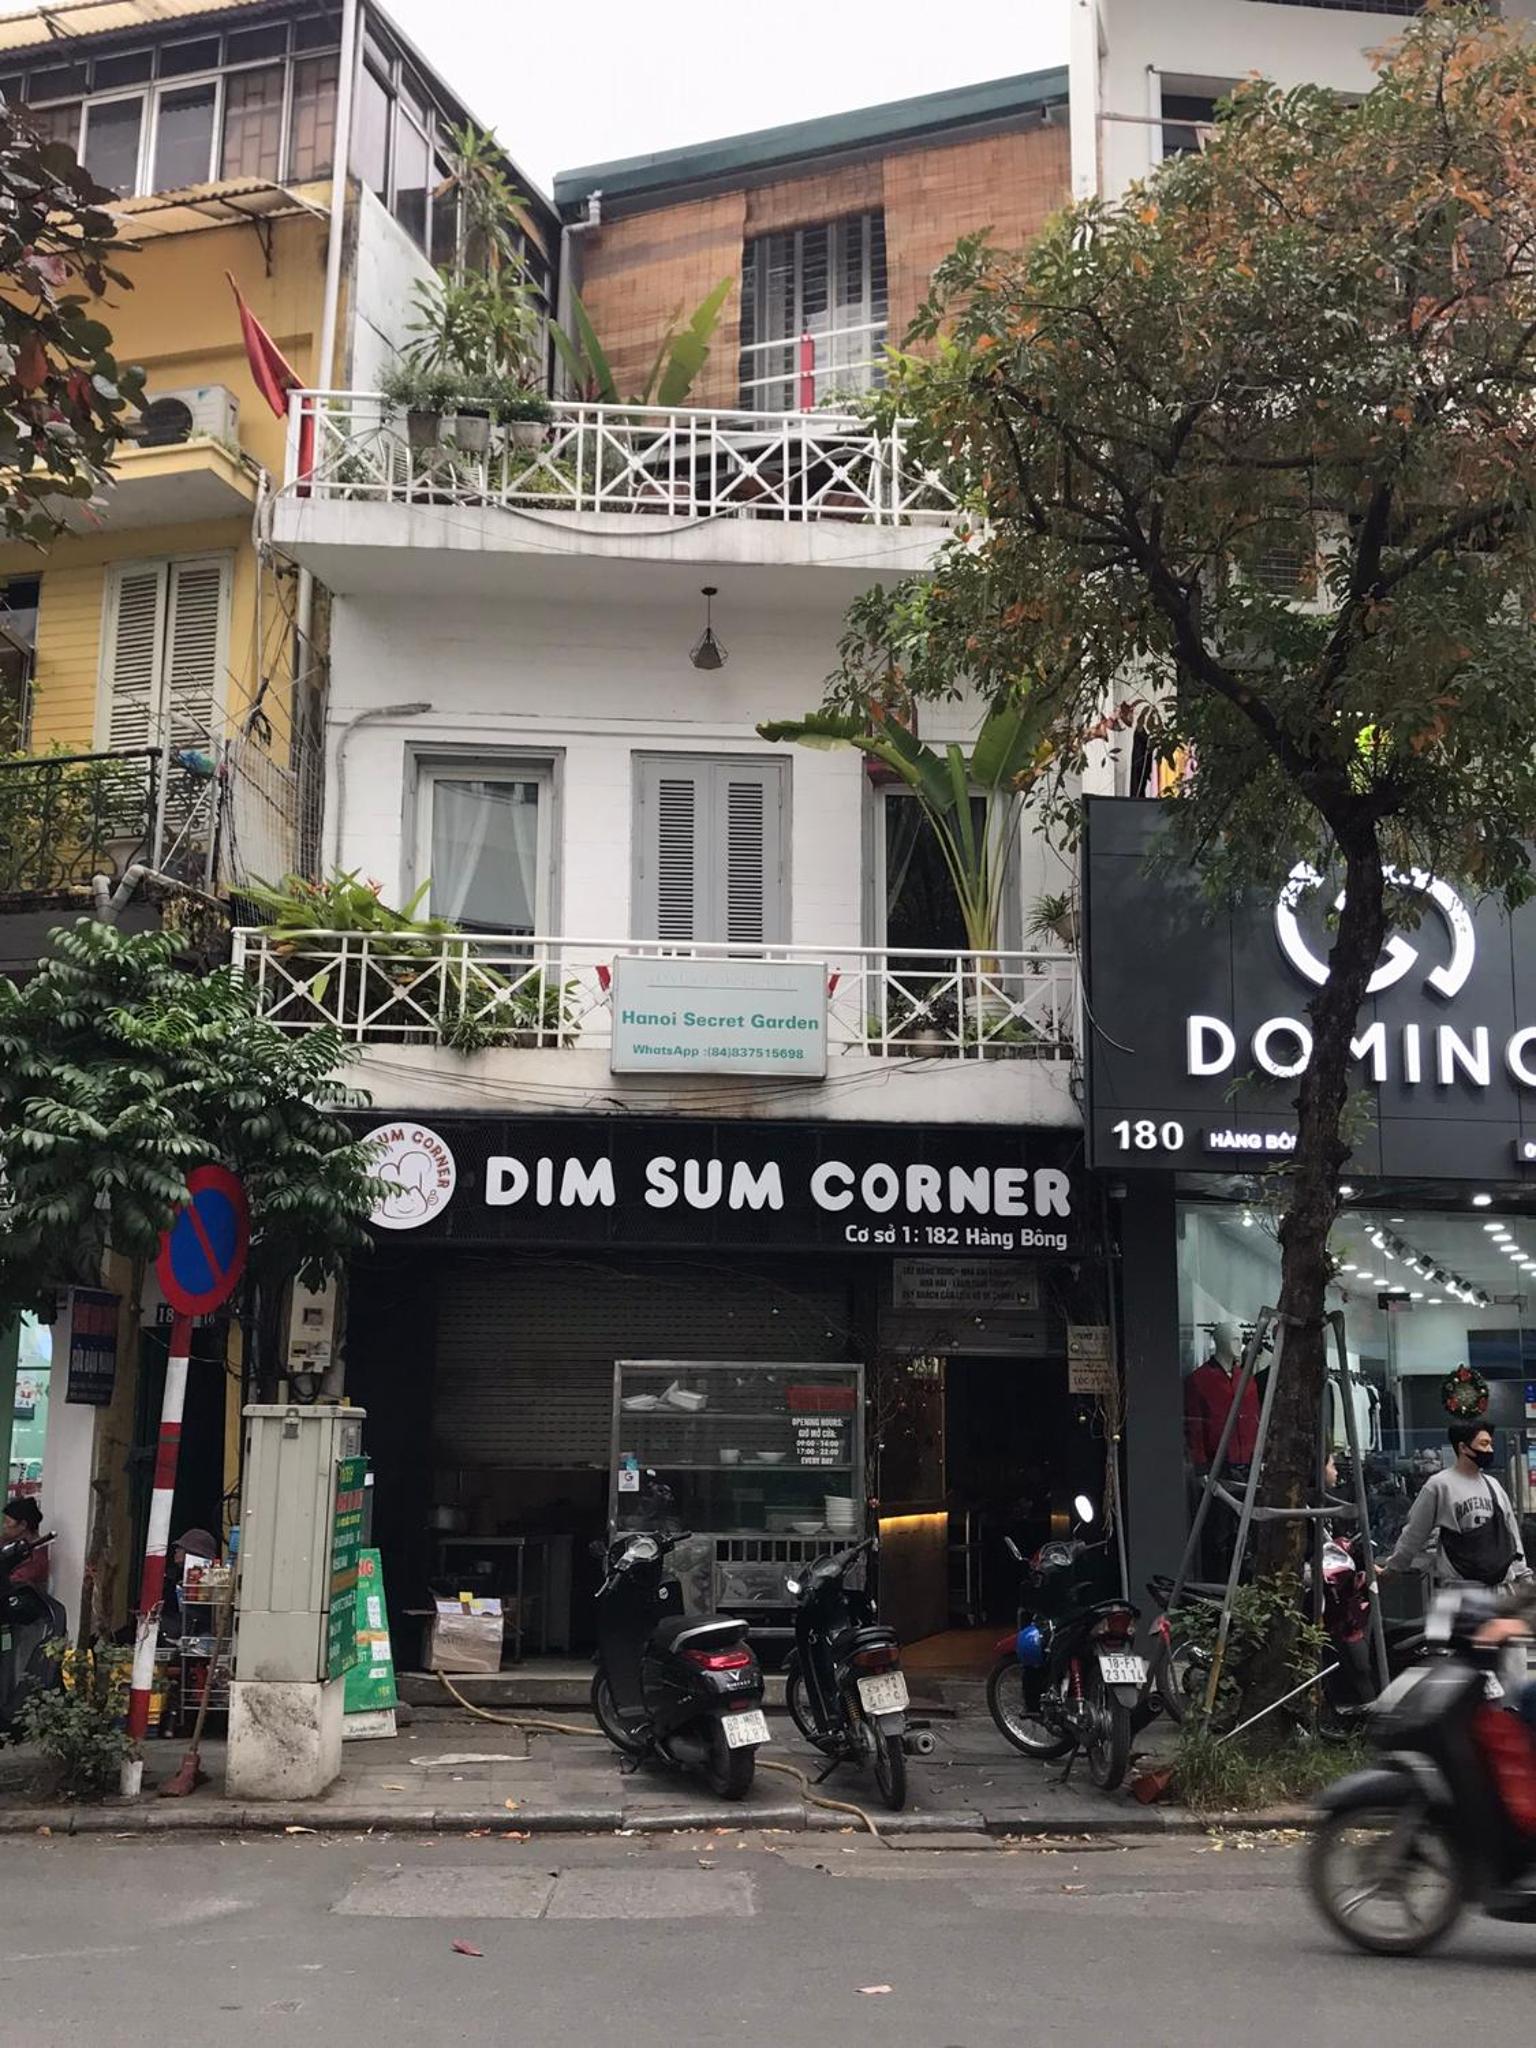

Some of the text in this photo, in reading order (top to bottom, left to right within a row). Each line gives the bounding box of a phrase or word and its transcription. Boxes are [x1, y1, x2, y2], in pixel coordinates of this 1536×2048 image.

[621, 1010, 819, 1030] Hanoi Secret Garden
[632, 1044, 700, 1058] WhatsApp
[1112, 1120, 1297, 1150] 180 HÀNG BÔ
[412, 1130, 452, 1189] CORNER
[485, 1155, 1072, 1218] DIM SUM CORNER
[844, 1225, 870, 1243] Cơ
[874, 1223, 896, 1244] sở
[925, 1226, 960, 1245] 182
[966, 1226, 1014, 1250] Hàng
[1020, 1228, 1068, 1251] Bông
